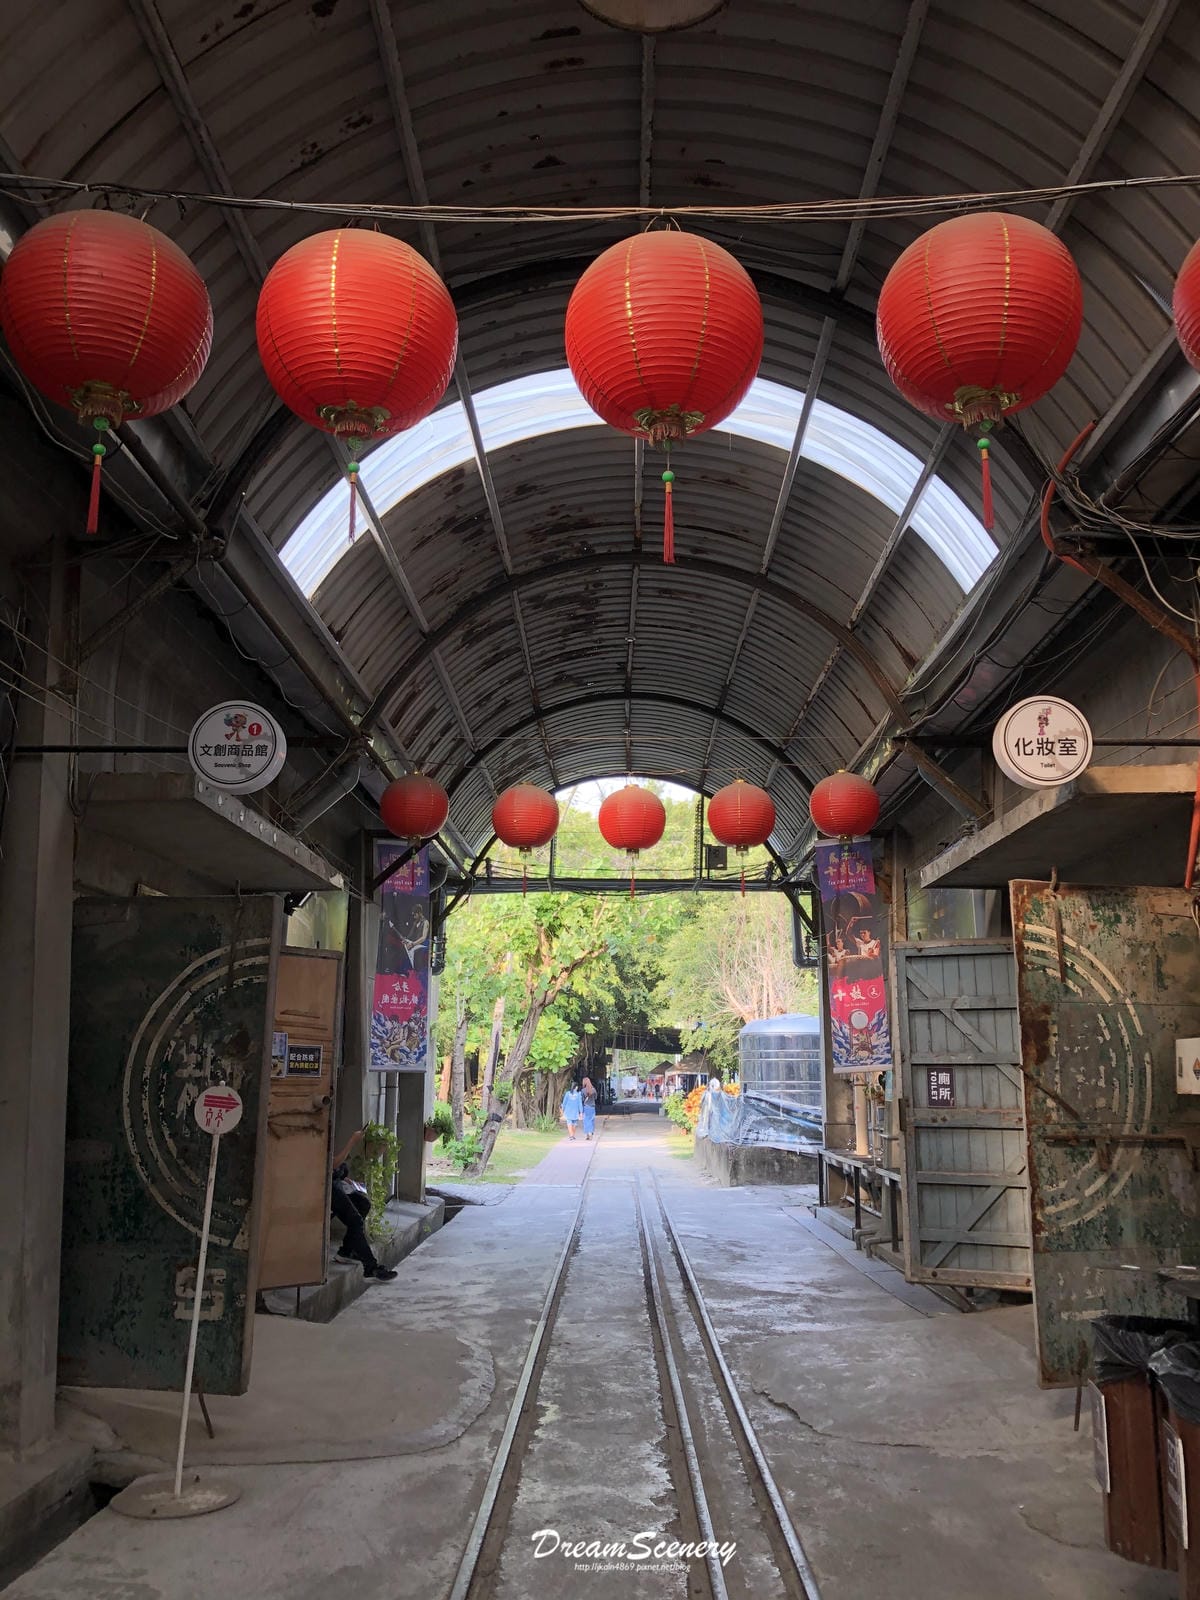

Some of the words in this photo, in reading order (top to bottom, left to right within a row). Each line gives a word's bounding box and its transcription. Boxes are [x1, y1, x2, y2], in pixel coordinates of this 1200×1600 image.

[199, 744, 268, 757] 文創商品館
[1014, 737, 1079, 757] 化妝室
[930, 1071, 938, 1100] TOILET
[938, 1072, 951, 1100] 廁所
